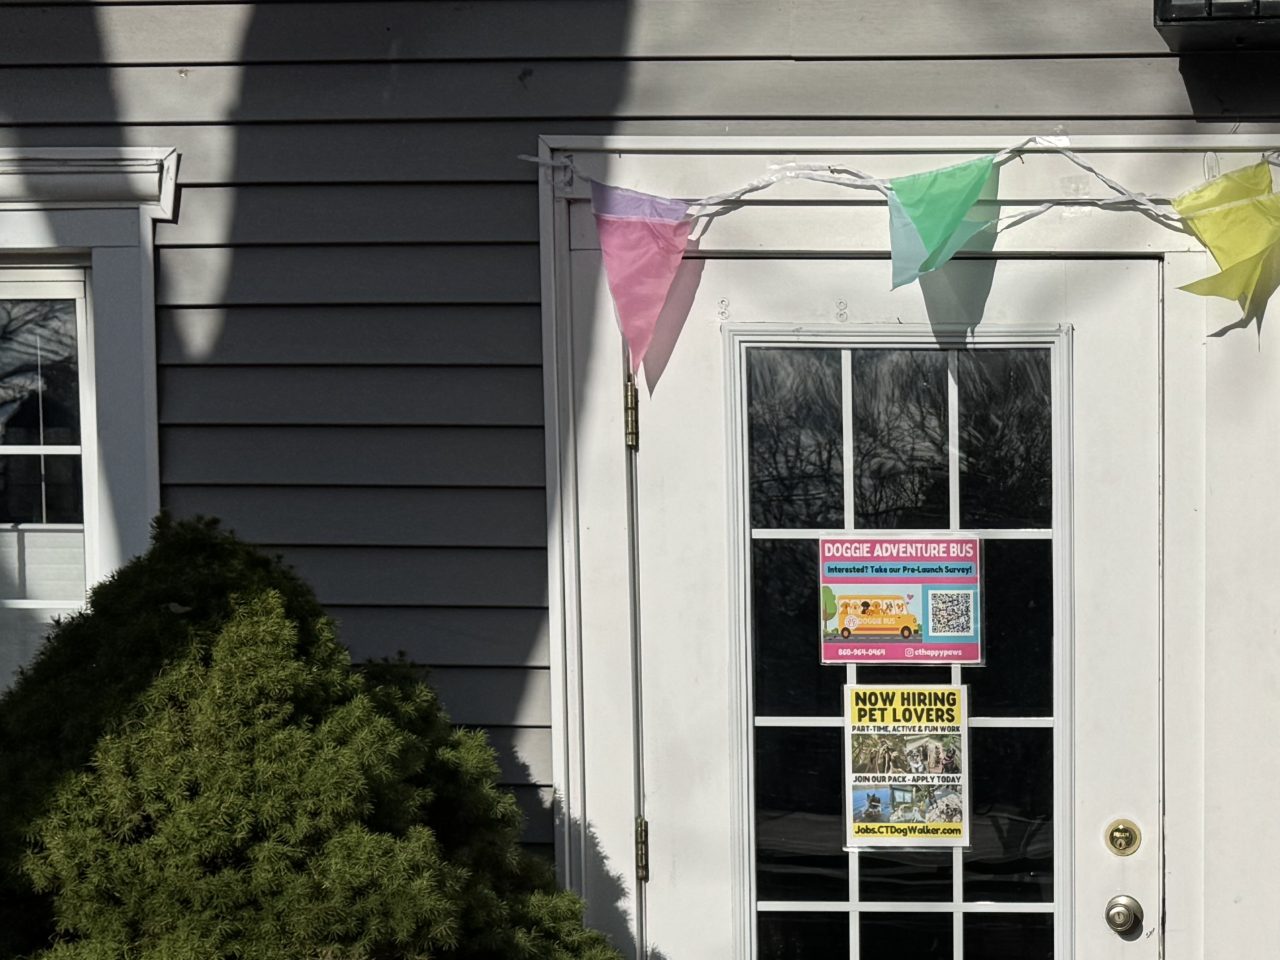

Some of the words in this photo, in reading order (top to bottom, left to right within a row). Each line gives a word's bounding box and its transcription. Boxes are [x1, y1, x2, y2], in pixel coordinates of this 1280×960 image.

[824, 543, 870, 557] DOGGIE
[874, 543, 947, 557] ADVENTURE
[950, 544, 974, 557] BUS
[828, 566, 868, 574] Interested?
[870, 566, 888, 574] Take
[902, 566, 944, 574] Pre-Launch
[944, 566, 972, 575] Survey!
[914, 648, 962, 657] cthappypaws
[855, 692, 896, 706] NOW
[900, 692, 956, 706] HIRING
[858, 708, 888, 722] PET
[892, 708, 955, 722] LOVERS
[854, 826, 961, 836] Jobs.CTDogWalker.com
